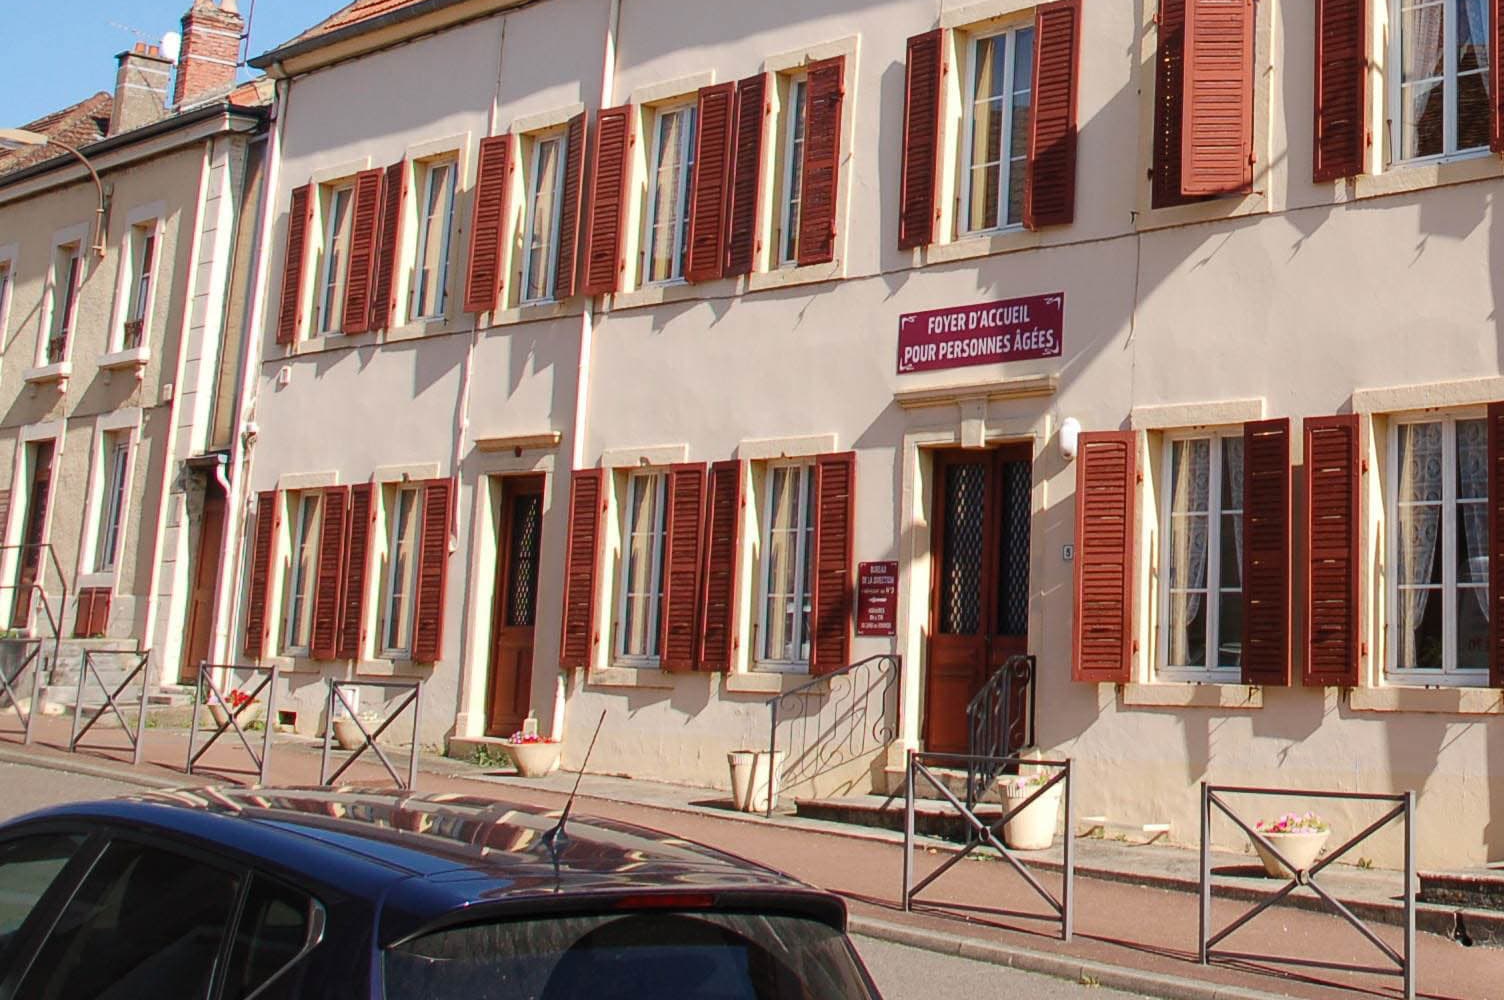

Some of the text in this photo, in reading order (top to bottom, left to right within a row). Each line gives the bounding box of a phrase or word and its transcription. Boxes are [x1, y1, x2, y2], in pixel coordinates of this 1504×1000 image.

[928, 305, 1031, 334] FOYER D'ACCUEIL
[904, 327, 1054, 364] POUR PERSONNES ÂGÉES
